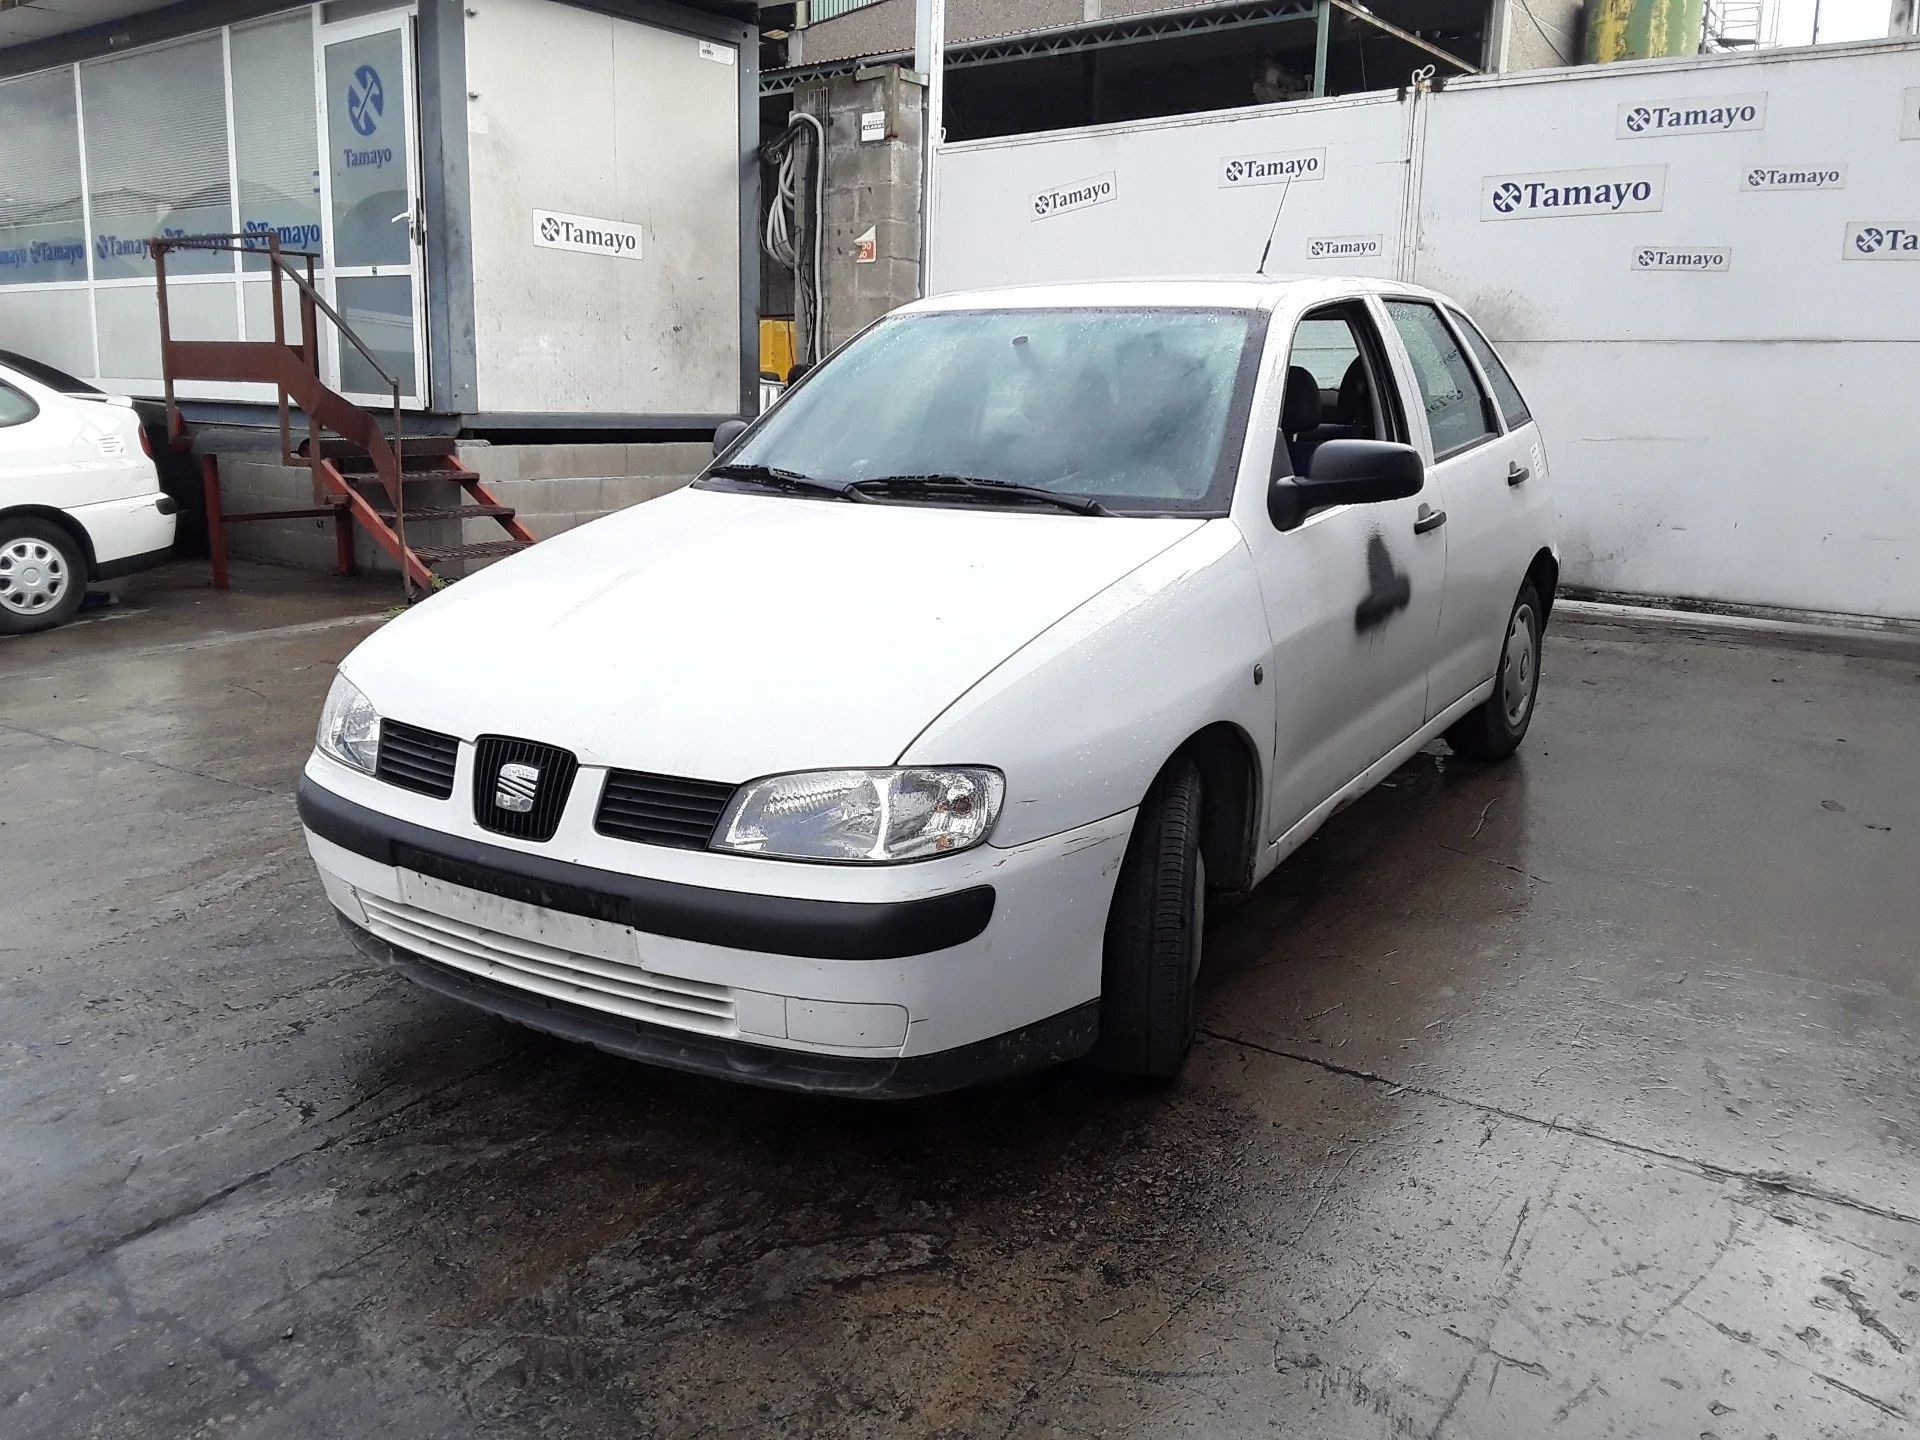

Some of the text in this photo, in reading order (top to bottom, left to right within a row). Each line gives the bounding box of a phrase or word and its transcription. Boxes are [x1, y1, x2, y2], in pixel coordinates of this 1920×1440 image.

[1653, 104, 1755, 128] Tamayo
[343, 148, 392, 169] Tamayo
[1245, 157, 1318, 178] Tamayo
[1767, 168, 1840, 186] Tamayo
[1049, 182, 1110, 209] Tamayo
[1524, 180, 1652, 210] Tamayo
[257, 222, 320, 249] Tmayo
[561, 221, 636, 253] Tamayo
[1886, 229, 1920, 252] Ta
[0, 245, 26, 268] mayo
[107, 235, 150, 260] Tamay
[1324, 241, 1377, 256] Tamayo
[1656, 251, 1724, 268] Tamayo
